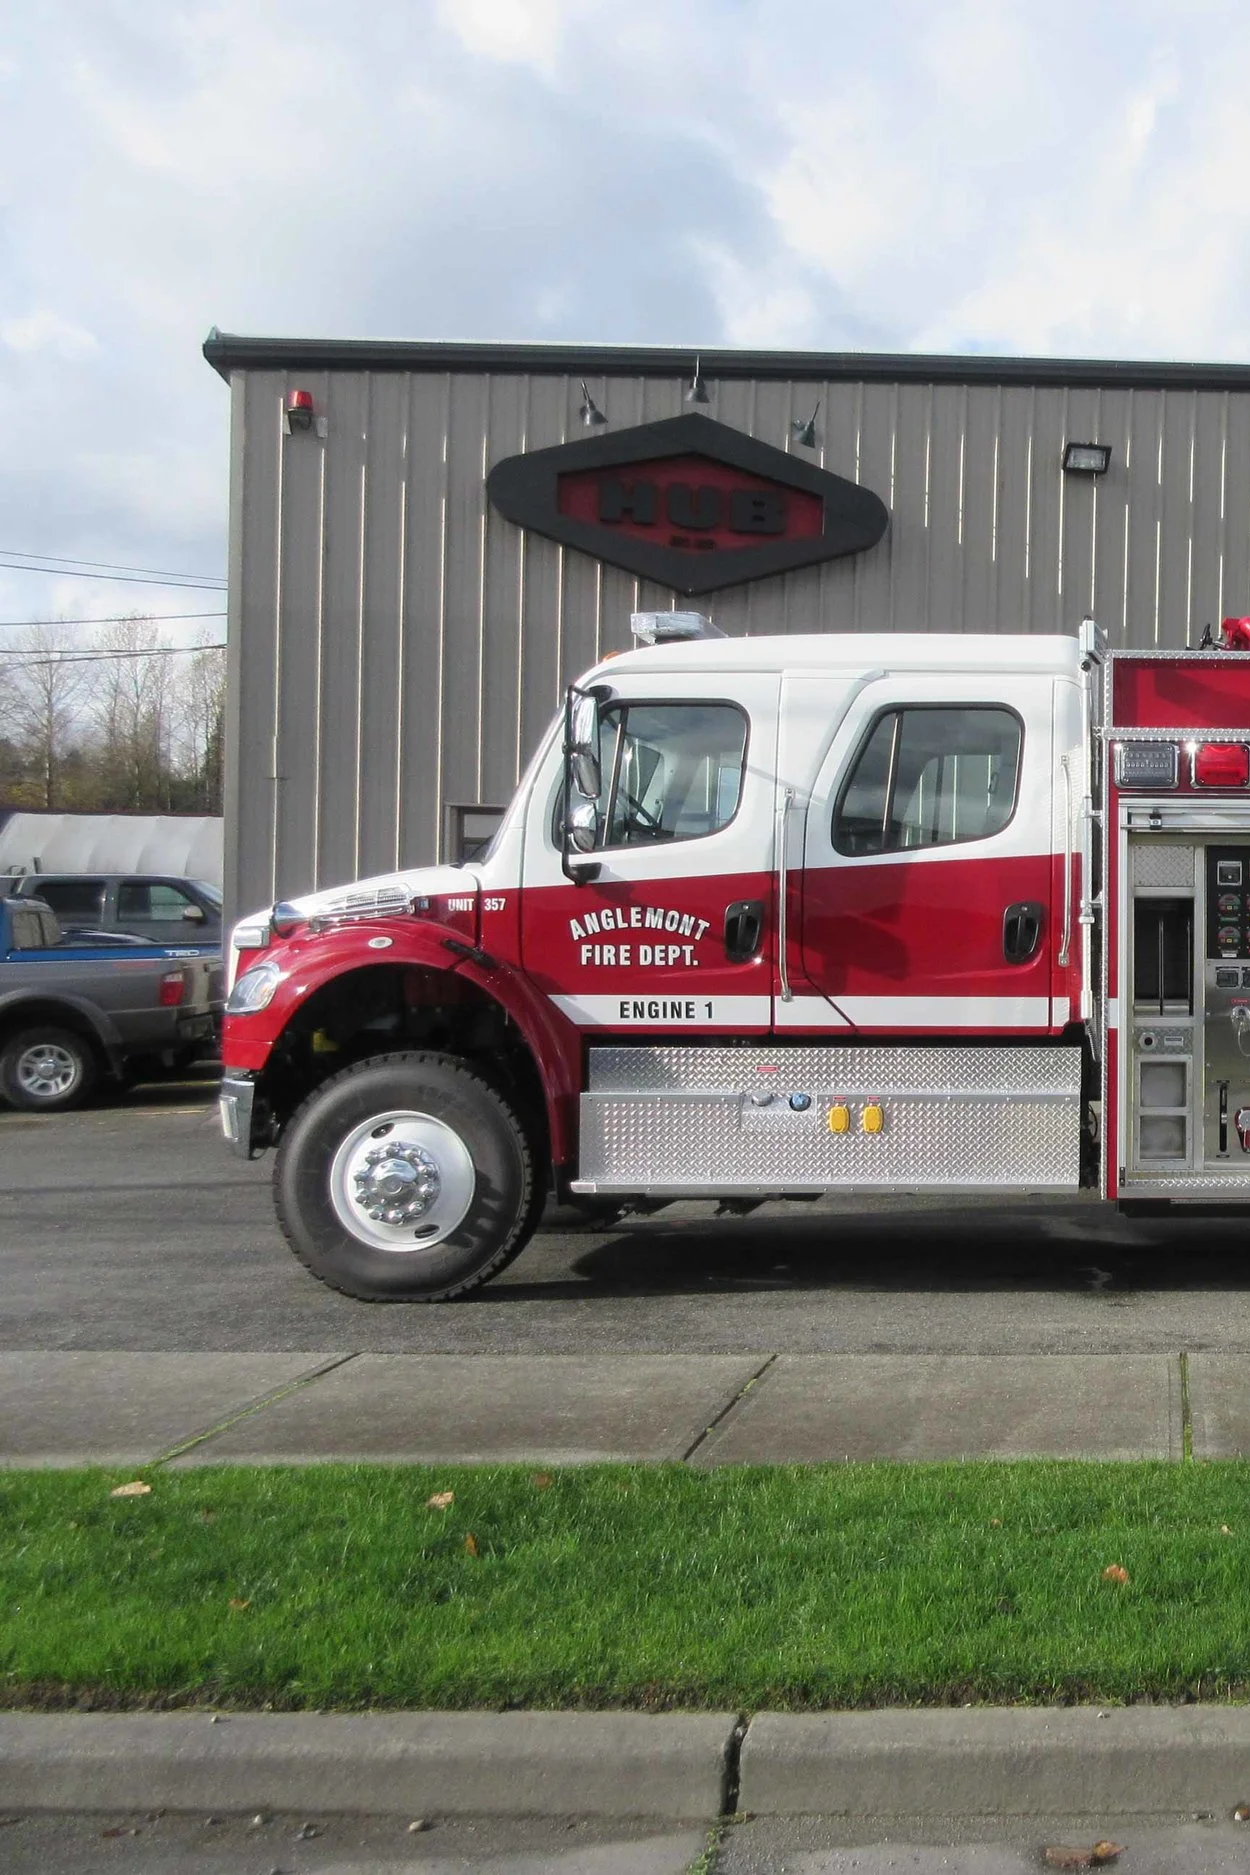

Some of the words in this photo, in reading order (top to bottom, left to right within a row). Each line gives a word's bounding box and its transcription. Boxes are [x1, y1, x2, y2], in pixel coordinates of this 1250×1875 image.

[598, 480, 786, 535] HUB
[448, 898, 475, 911] UNIT
[484, 898, 506, 911] 357
[569, 907, 710, 941] ANGLEMONT
[581, 944, 631, 966] FIRE
[639, 944, 699, 966] DEPT.
[619, 1001, 696, 1019] ENGINE
[704, 1001, 713, 1019] 1
